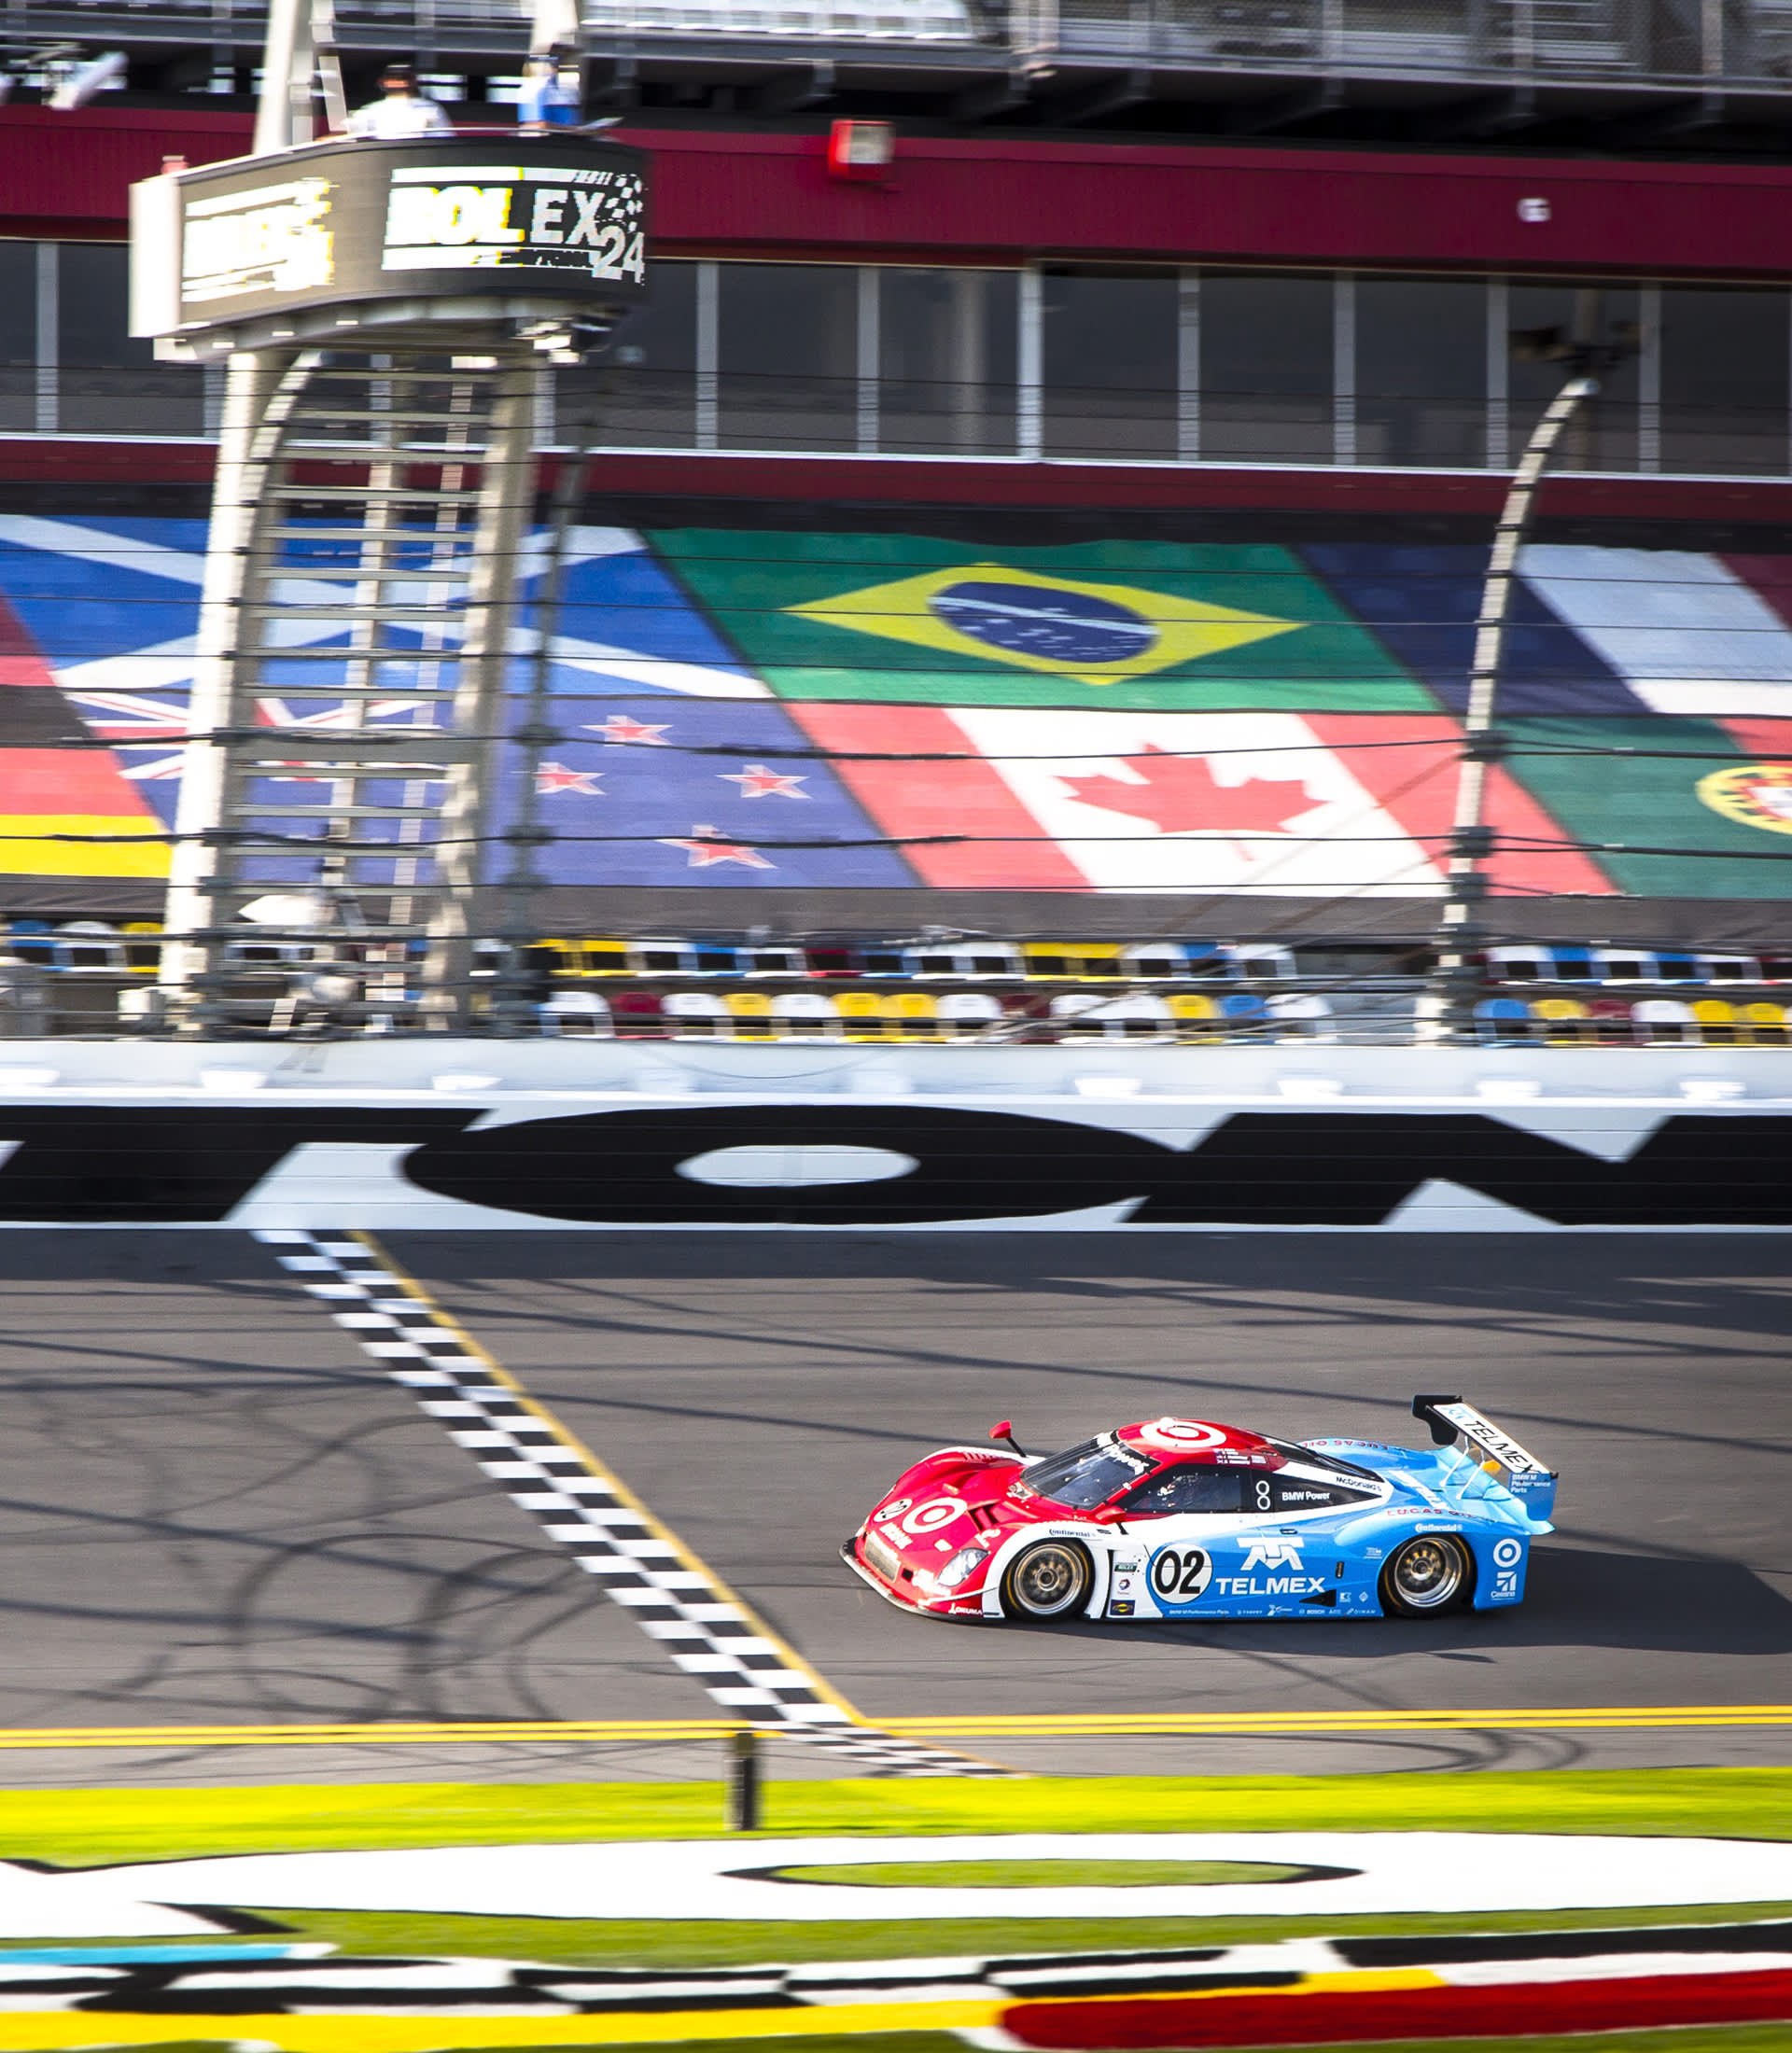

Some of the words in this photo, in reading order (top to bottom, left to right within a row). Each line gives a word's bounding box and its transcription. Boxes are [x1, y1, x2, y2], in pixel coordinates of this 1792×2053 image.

[591, 225, 646, 284] 24
[1463, 1419, 1543, 1474] TELMEX
[1281, 1491, 1304, 1501] BMW
[1305, 1491, 1330, 1501] Power
[1387, 1508, 1443, 1516] LUCAS
[1155, 1549, 1205, 1595] 02
[1215, 1577, 1326, 1595] TELMEX
